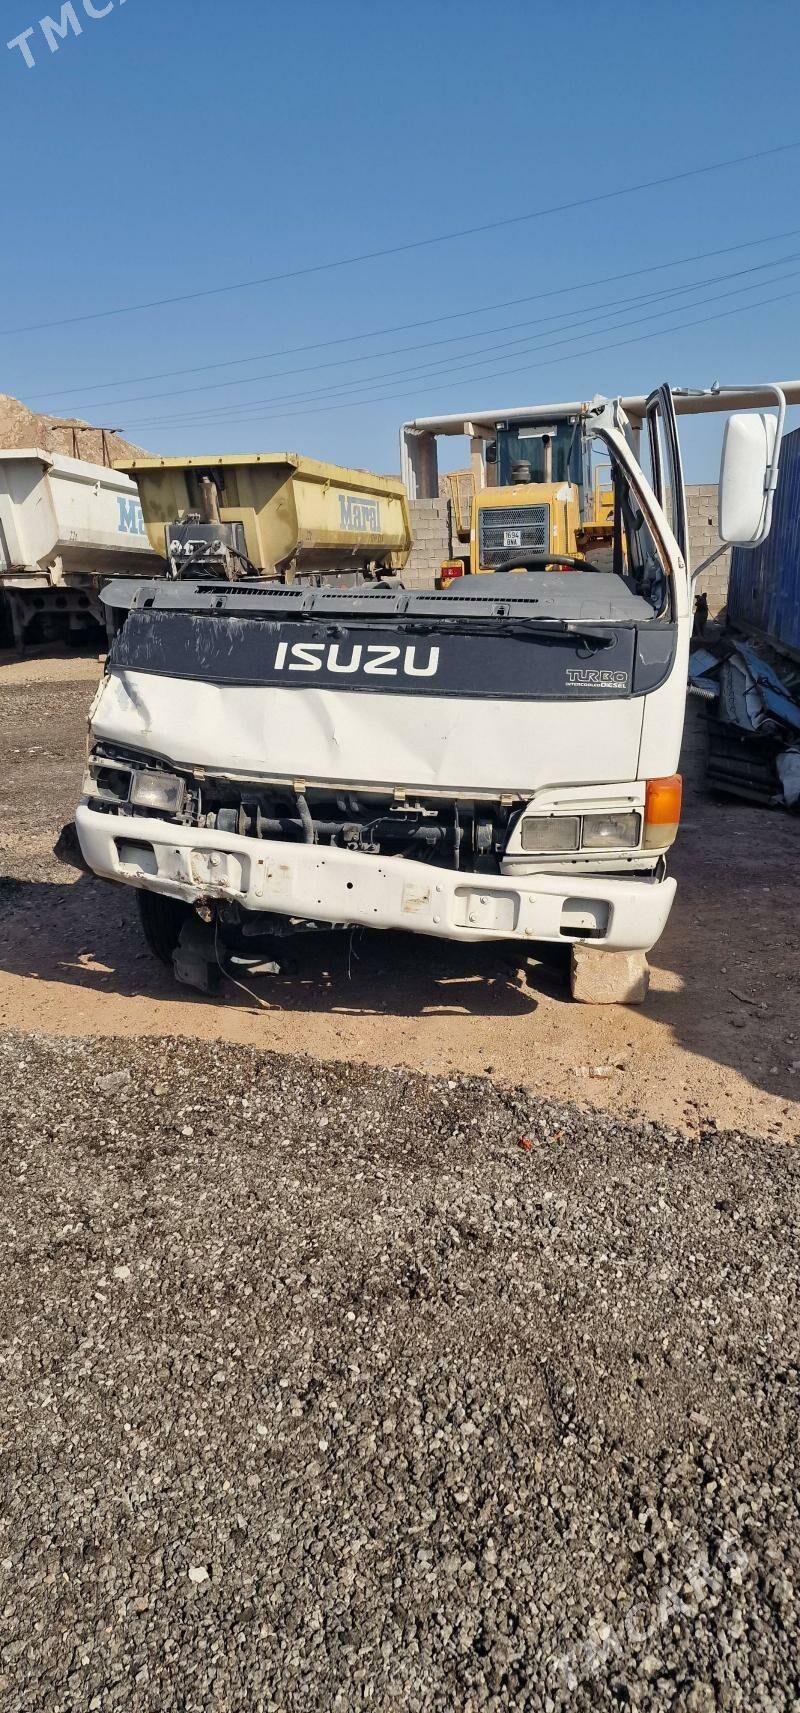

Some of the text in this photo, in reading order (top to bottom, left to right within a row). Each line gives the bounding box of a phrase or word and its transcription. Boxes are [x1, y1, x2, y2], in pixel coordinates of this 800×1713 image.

[338, 494, 381, 532] Maral
[274, 642, 440, 677] ISUZU
[566, 669, 628, 682] TURBO
